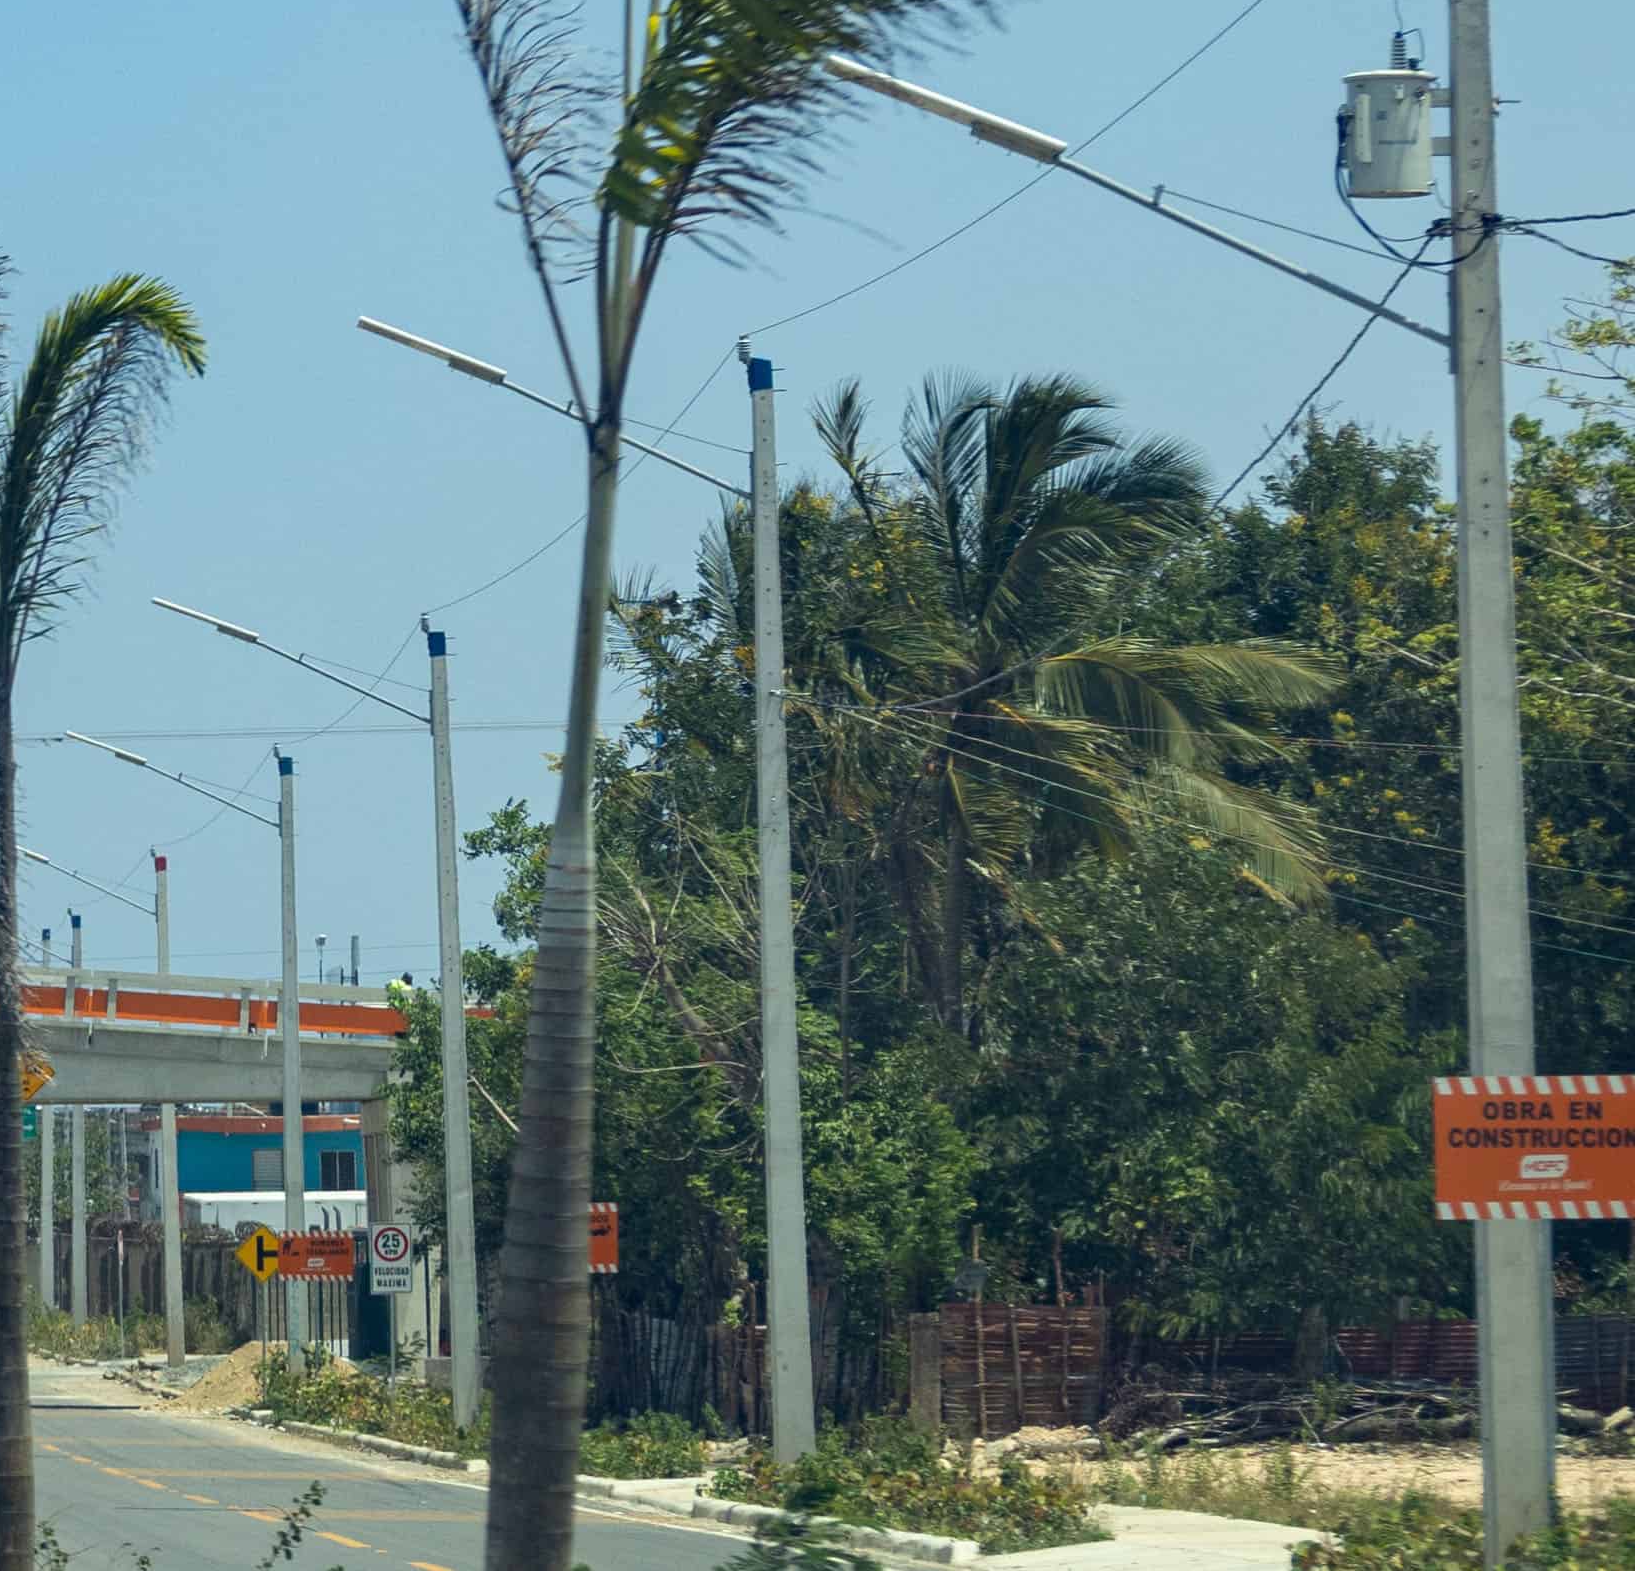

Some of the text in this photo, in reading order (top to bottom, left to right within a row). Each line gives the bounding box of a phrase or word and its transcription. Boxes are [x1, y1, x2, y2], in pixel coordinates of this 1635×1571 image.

[1482, 1101, 1603, 1120] OBRA EN
[382, 1234, 400, 1248] 25
